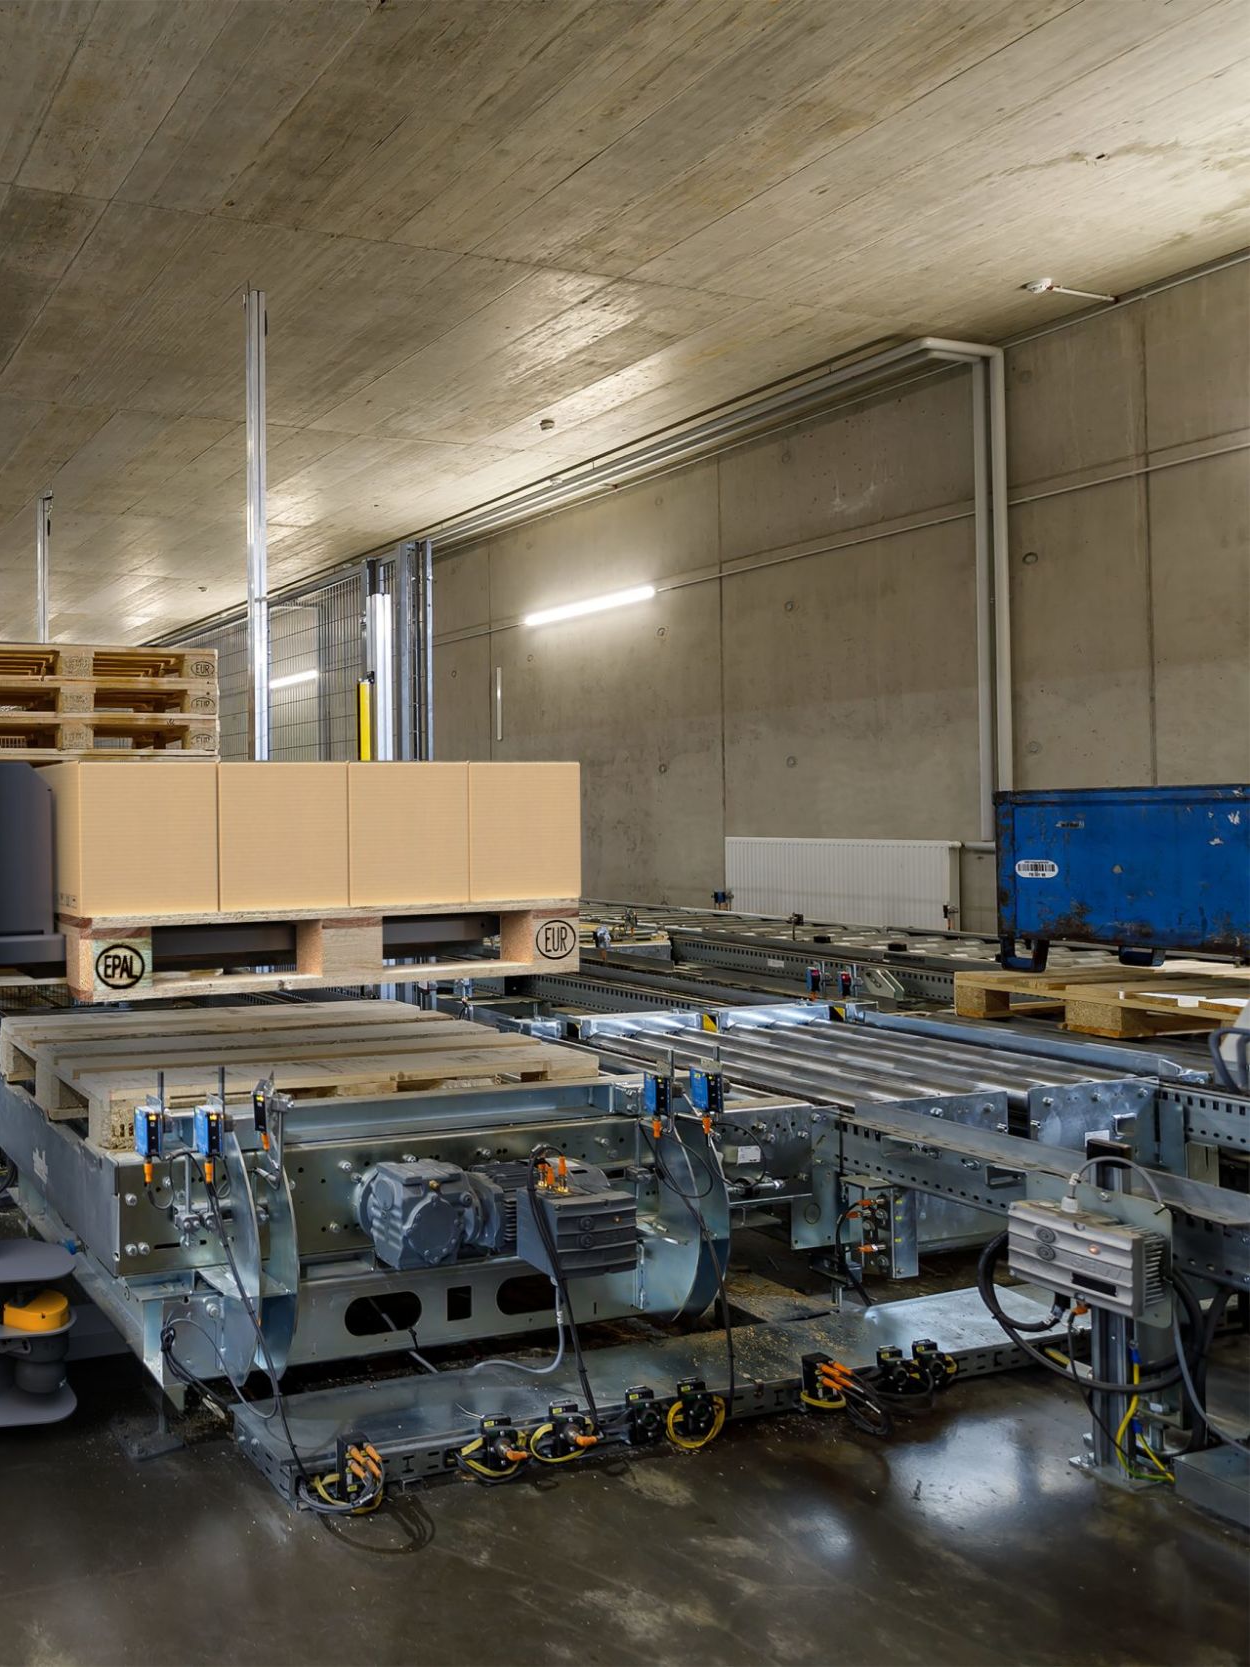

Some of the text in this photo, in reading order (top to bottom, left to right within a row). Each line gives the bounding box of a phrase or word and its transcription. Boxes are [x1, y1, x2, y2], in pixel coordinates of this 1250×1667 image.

[195, 664, 210, 674] EUR
[545, 926, 568, 953] EUR
[103, 954, 139, 979] EPAL
